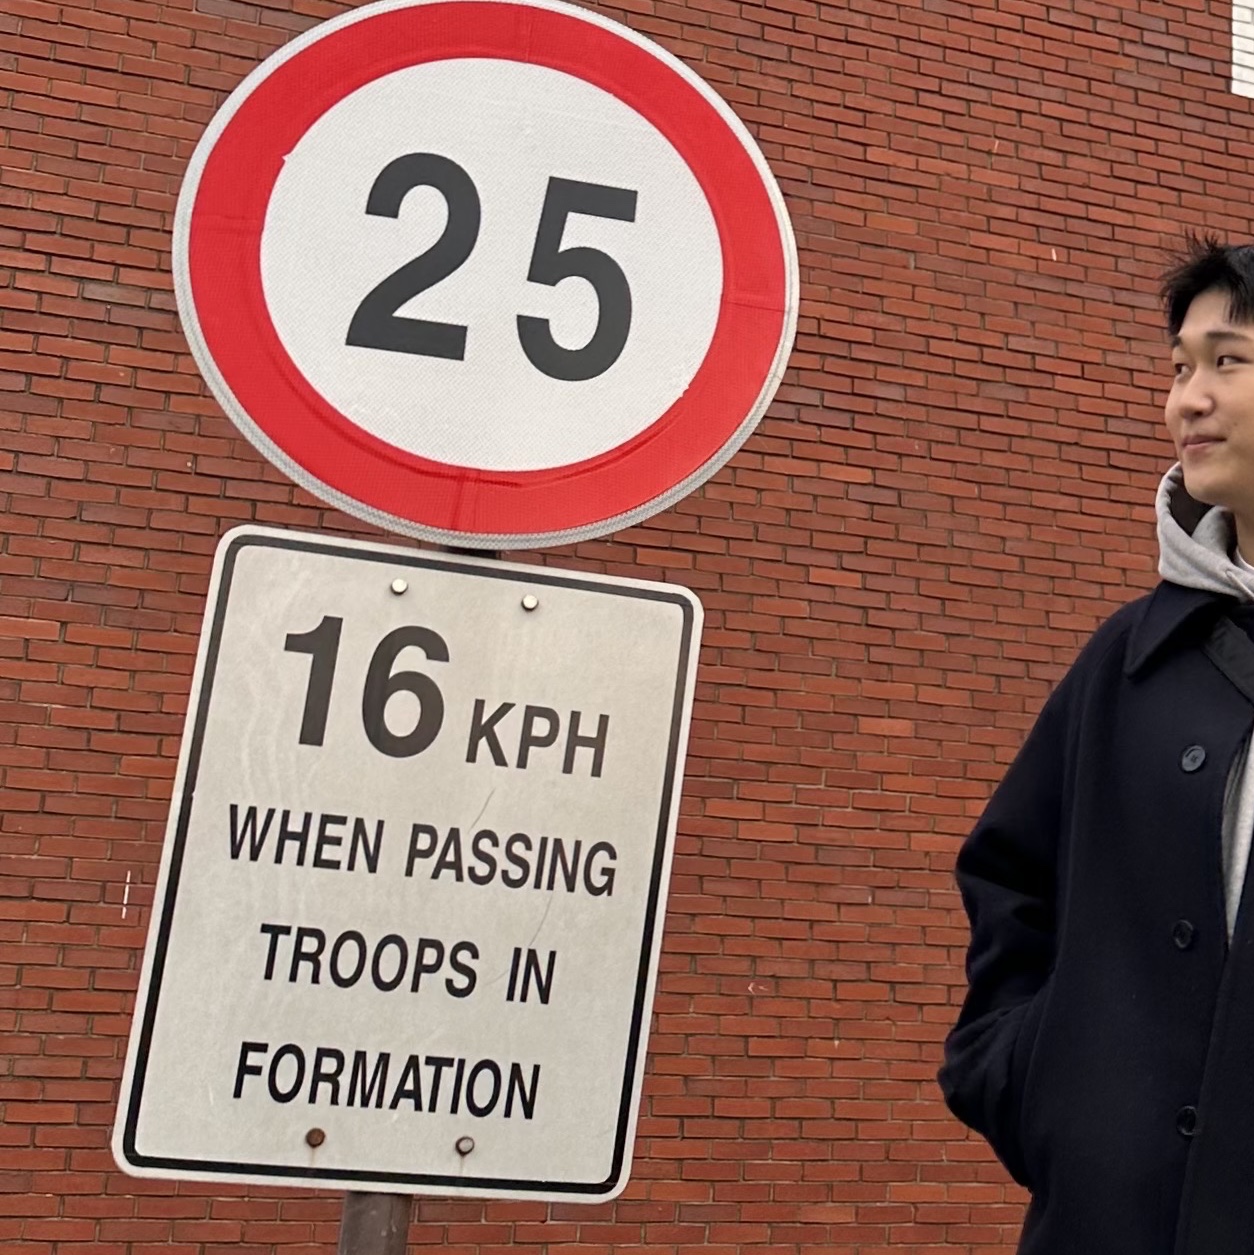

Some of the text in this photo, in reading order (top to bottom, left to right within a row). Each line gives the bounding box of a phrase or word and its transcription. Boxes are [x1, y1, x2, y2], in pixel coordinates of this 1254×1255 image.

[345, 152, 639, 382] 25
[284, 615, 611, 778] 16 KPH
[228, 804, 619, 897] WHEN PASSING
[259, 923, 557, 1005] TROOPS IN
[232, 1041, 541, 1121] FORMATION
